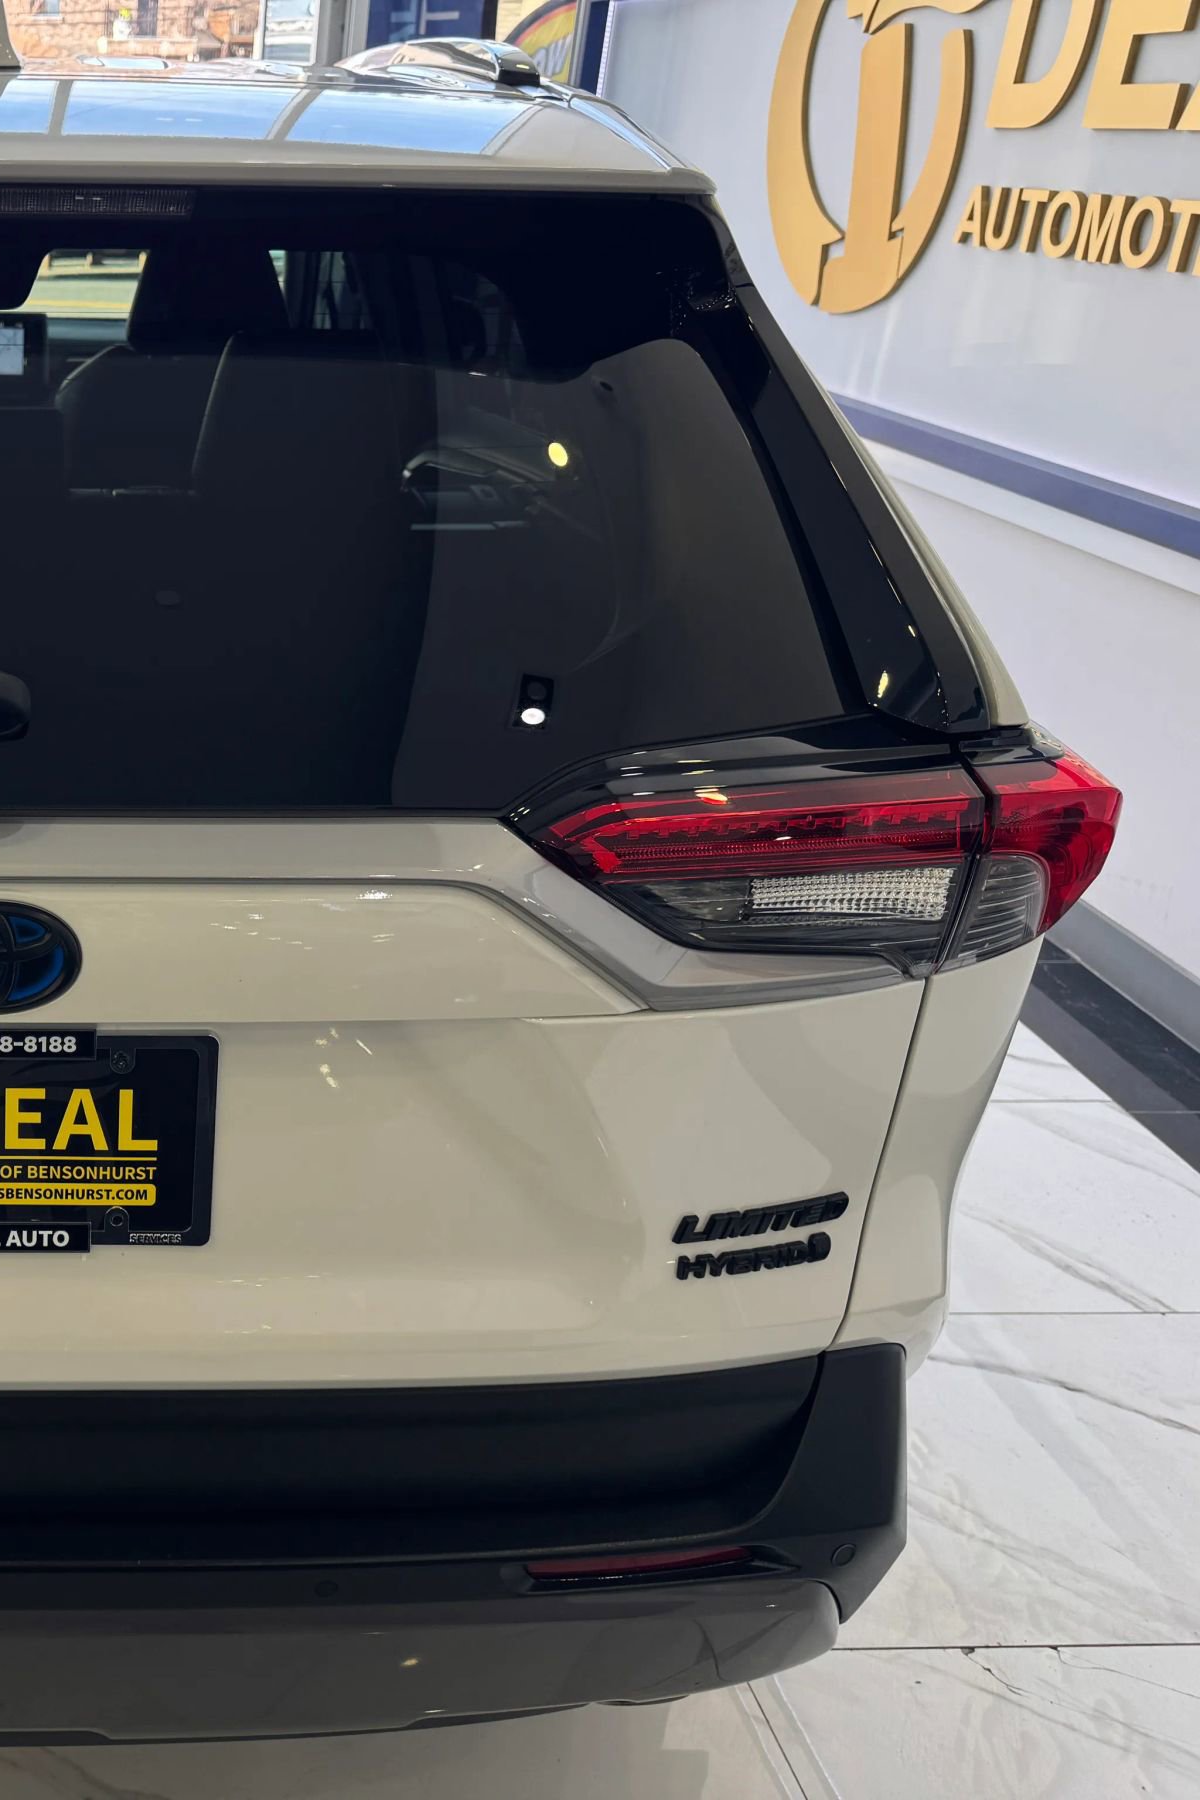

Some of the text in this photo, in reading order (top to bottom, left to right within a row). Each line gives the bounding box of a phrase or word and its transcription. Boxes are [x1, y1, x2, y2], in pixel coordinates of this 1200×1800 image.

[954, 184, 1200, 277] AUTOMOT
[0, 1165, 23, 1179] OF
[27, 1165, 157, 1180] BENSONHURST
[672, 1191, 850, 1244] LIMITED
[6, 1230, 70, 1247] AUTO
[129, 1233, 182, 1244] SERVICES
[676, 1240, 809, 1280] HYBRID
